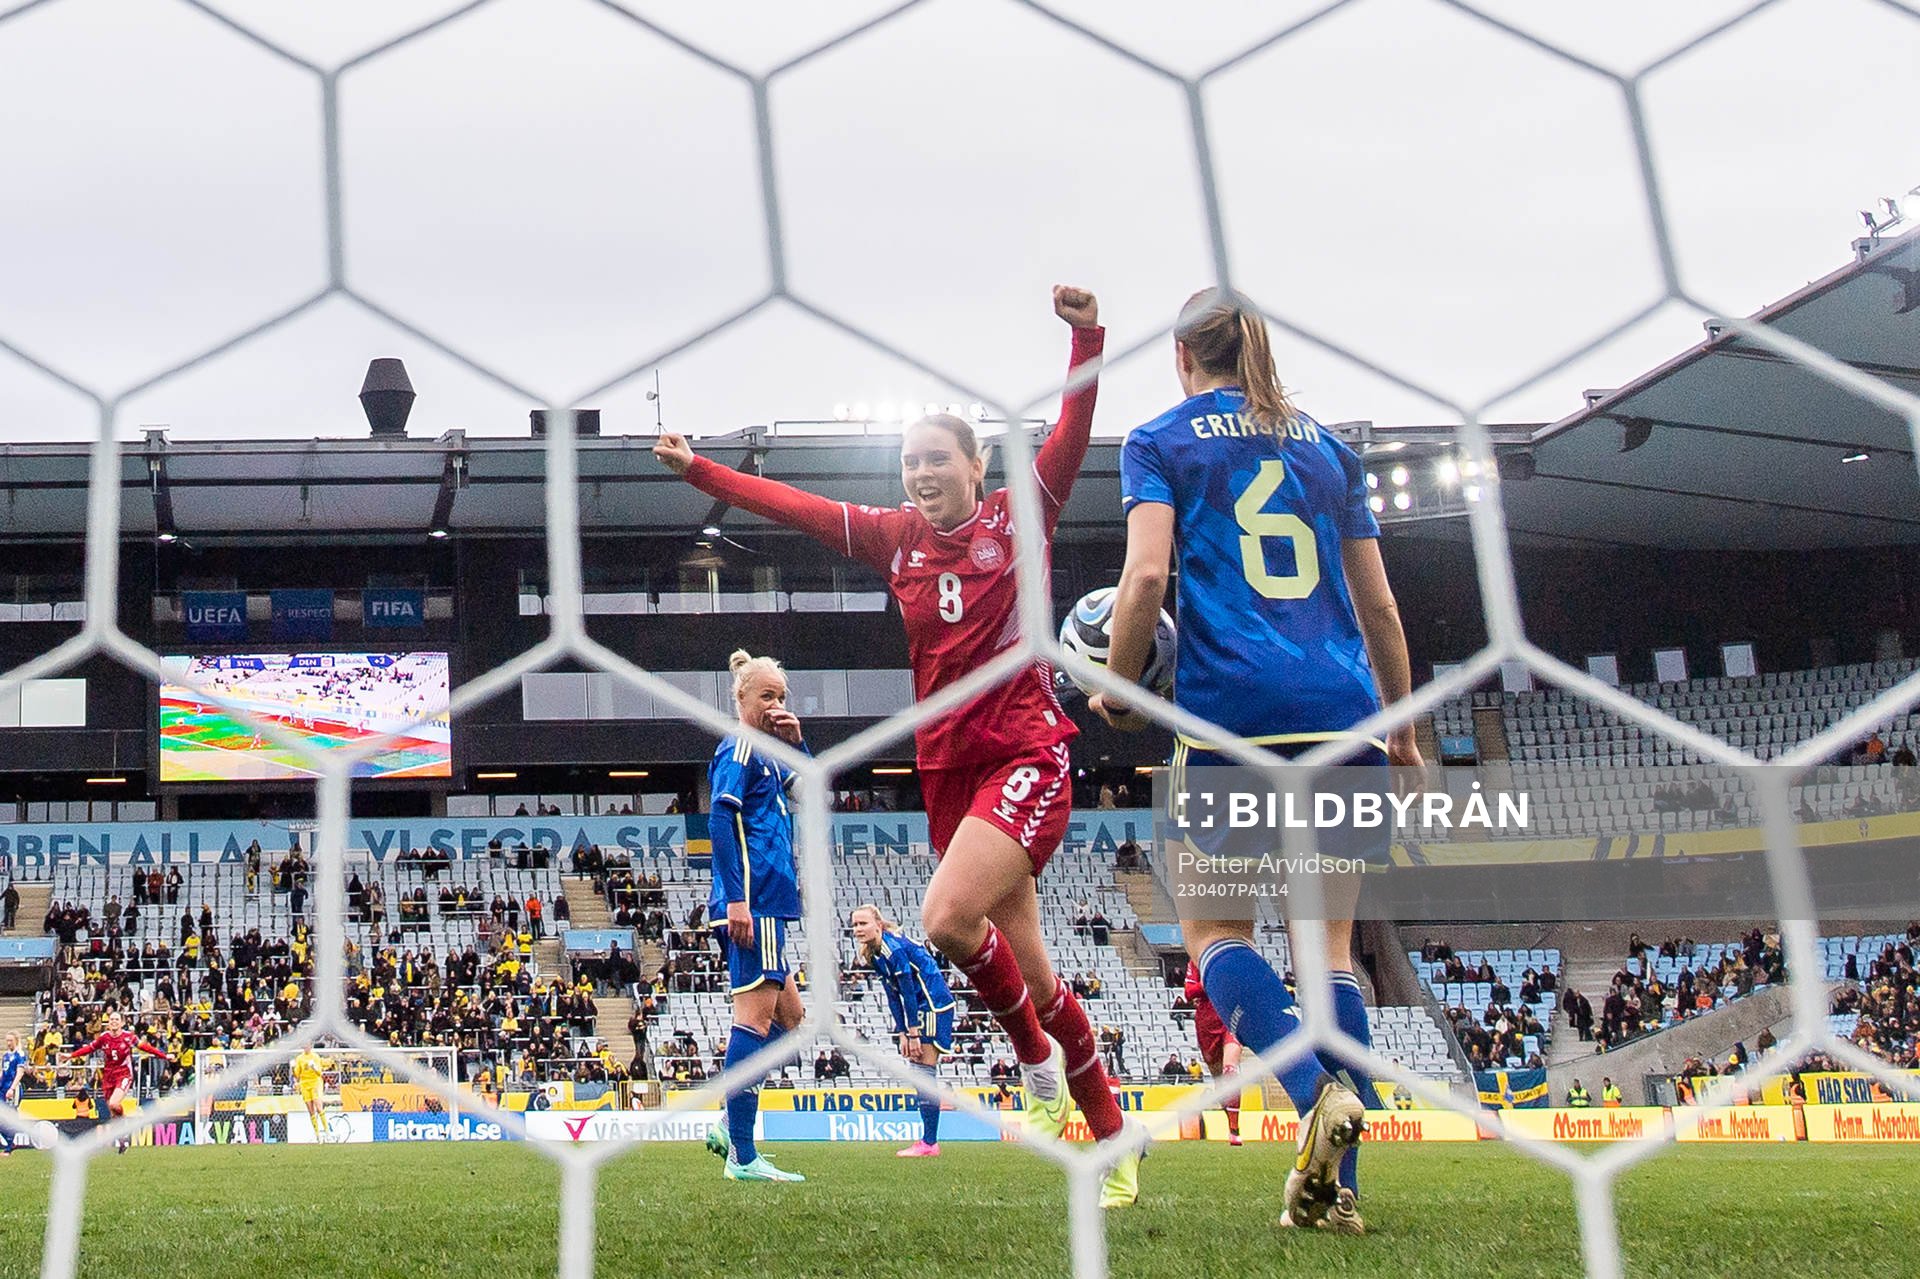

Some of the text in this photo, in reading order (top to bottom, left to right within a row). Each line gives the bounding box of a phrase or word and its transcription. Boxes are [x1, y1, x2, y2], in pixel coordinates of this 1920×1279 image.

[1234, 459, 1320, 599] 6
[372, 600, 415, 616] FIFA
[938, 572, 963, 623] 8
[188, 607, 241, 624] UEFA
[1002, 766, 1040, 801] 8
[128, 831, 246, 863] ALLA
[616, 826, 679, 857] SK
[860, 1093, 919, 1111] SVER
[1817, 1077, 1843, 1104] HÄR
[388, 1118, 503, 1141] latravel.se
